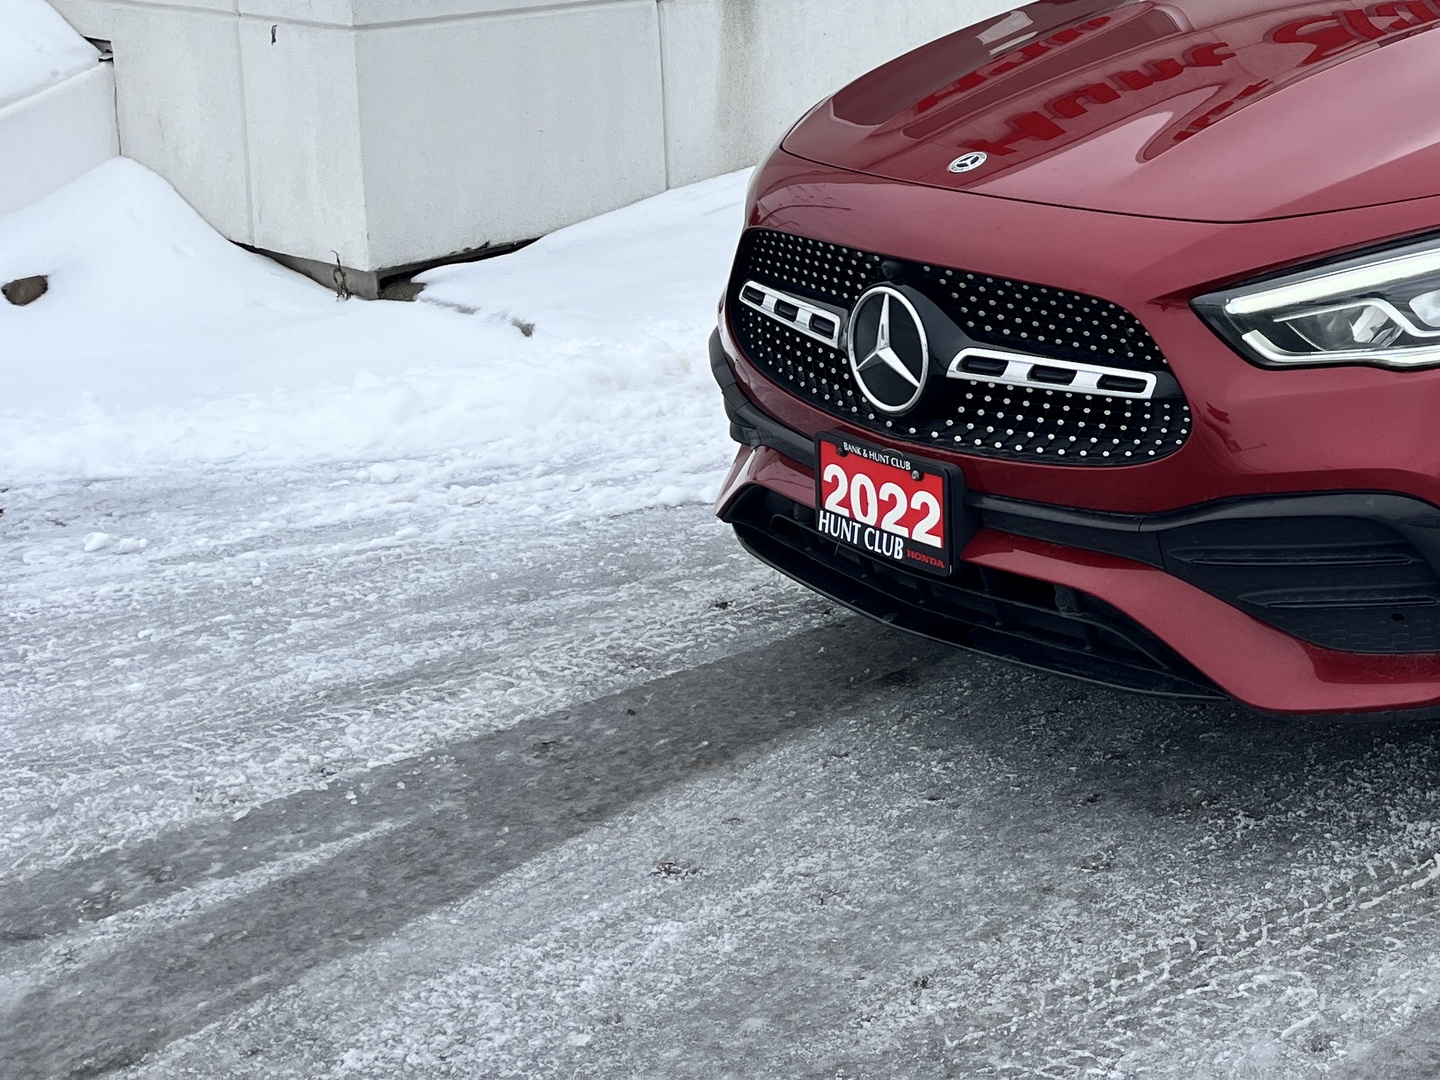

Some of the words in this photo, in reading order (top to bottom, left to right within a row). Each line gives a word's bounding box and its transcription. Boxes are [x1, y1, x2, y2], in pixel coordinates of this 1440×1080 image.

[843, 441, 862, 457] BANK
[862, 449, 869, 458] &
[869, 451, 890, 465] HUNT
[890, 457, 911, 471] CLUB
[823, 463, 943, 549] 2022
[818, 509, 862, 546] HUNT
[864, 527, 904, 560] CLUB
[906, 549, 946, 569] HONDA
